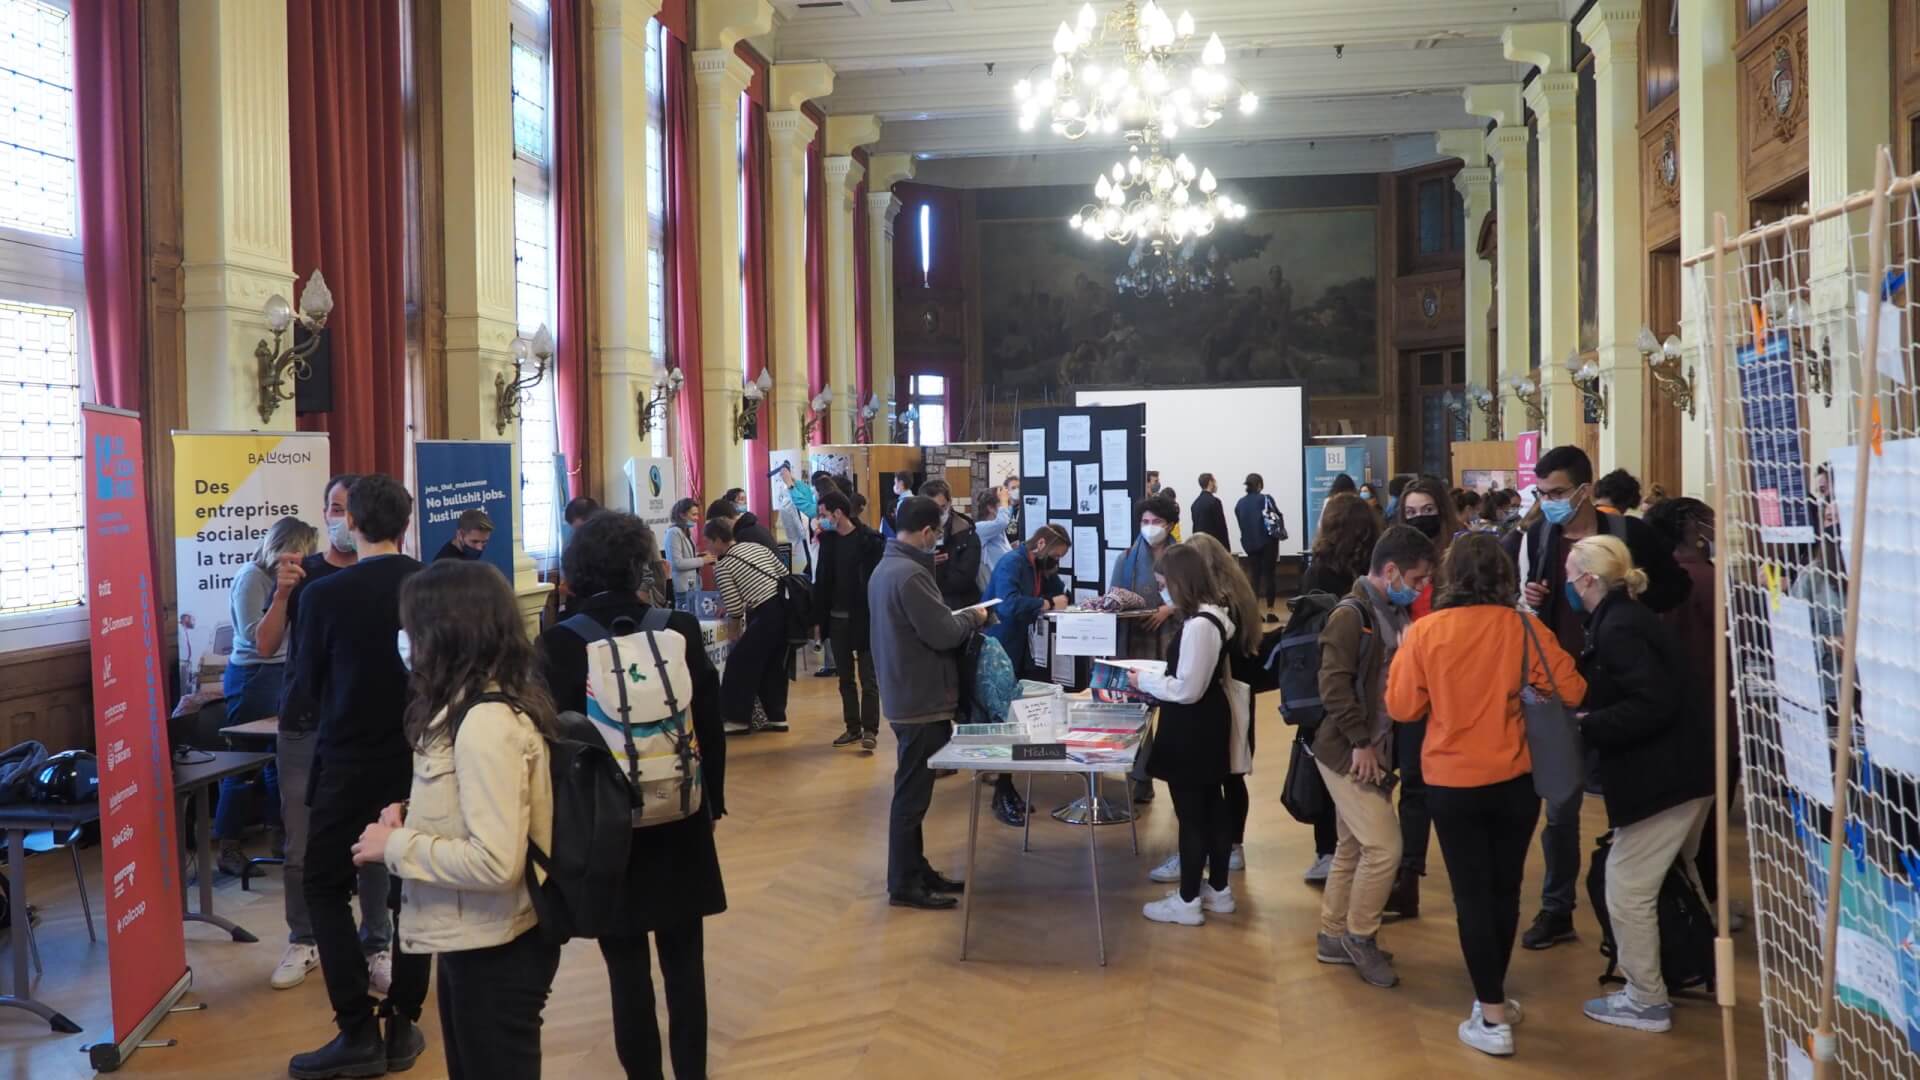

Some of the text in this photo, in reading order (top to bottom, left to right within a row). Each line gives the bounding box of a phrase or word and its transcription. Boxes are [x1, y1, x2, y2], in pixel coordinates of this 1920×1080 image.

[248, 451, 311, 464] BALUCHON
[195, 479, 230, 495] Des
[426, 489, 506, 509] No bullshit jobs.
[195, 501, 299, 520] entreprises
[428, 510, 450, 523] Just
[196, 526, 268, 543] sociales
[197, 551, 258, 566] la tran
[198, 574, 234, 591] alim
